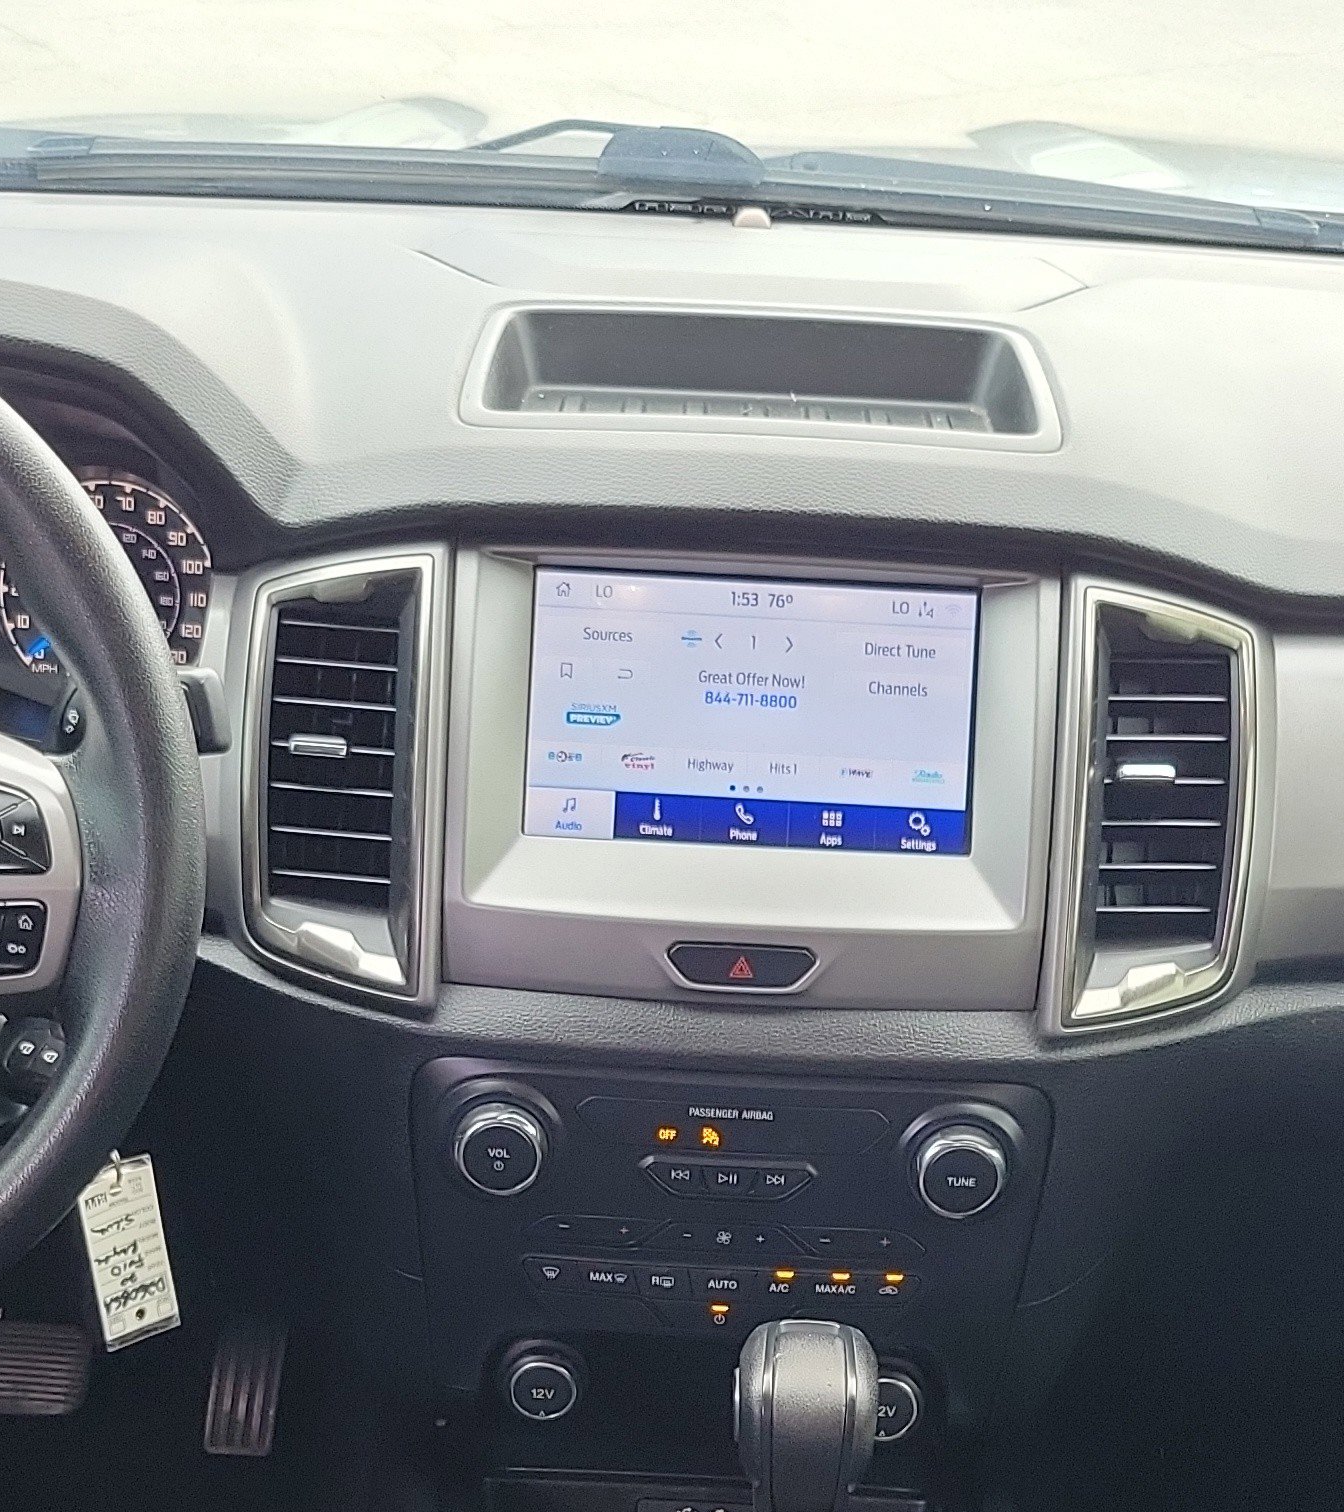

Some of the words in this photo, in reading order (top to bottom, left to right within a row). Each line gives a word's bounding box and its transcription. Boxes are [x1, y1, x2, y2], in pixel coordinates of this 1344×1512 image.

[116, 496, 135, 512] 70
[146, 511, 165, 525] 80
[168, 532, 186, 546] 90
[182, 560, 203, 575] 100
[595, 585, 613, 598] LO
[190, 592, 206, 607] 110
[731, 591, 759, 607] 1:53
[892, 601, 910, 615] LO
[17, 614, 30, 629] 10
[181, 624, 202, 638] 120
[583, 626, 633, 643] Sources
[864, 642, 902, 658] Direct
[906, 644, 936, 659] Tune
[31, 663, 58, 674] MPH
[698, 670, 732, 686] Great
[736, 671, 769, 687] Offer
[772, 674, 806, 689] Now!
[868, 681, 928, 698] Channels
[704, 690, 798, 710] 844-711-8800
[687, 758, 734, 772] Highway
[769, 763, 791, 775] Hits
[555, 820, 582, 831] Audio
[639, 823, 673, 837] Climate
[729, 828, 757, 841] Phone
[819, 832, 842, 847] Apps
[900, 838, 937, 851] Settings
[688, 1107, 739, 1119] PASSENGER
[741, 1110, 774, 1120] AIRBAG
[659, 1128, 677, 1140] OFF
[487, 1148, 511, 1158] VOL
[947, 1176, 976, 1187] TUNE
[590, 1272, 613, 1283] MAX
[708, 1279, 737, 1290] AUTO
[769, 1283, 790, 1293] A/C
[531, 1388, 555, 1399] 12V
[877, 1405, 896, 1417] 2V
